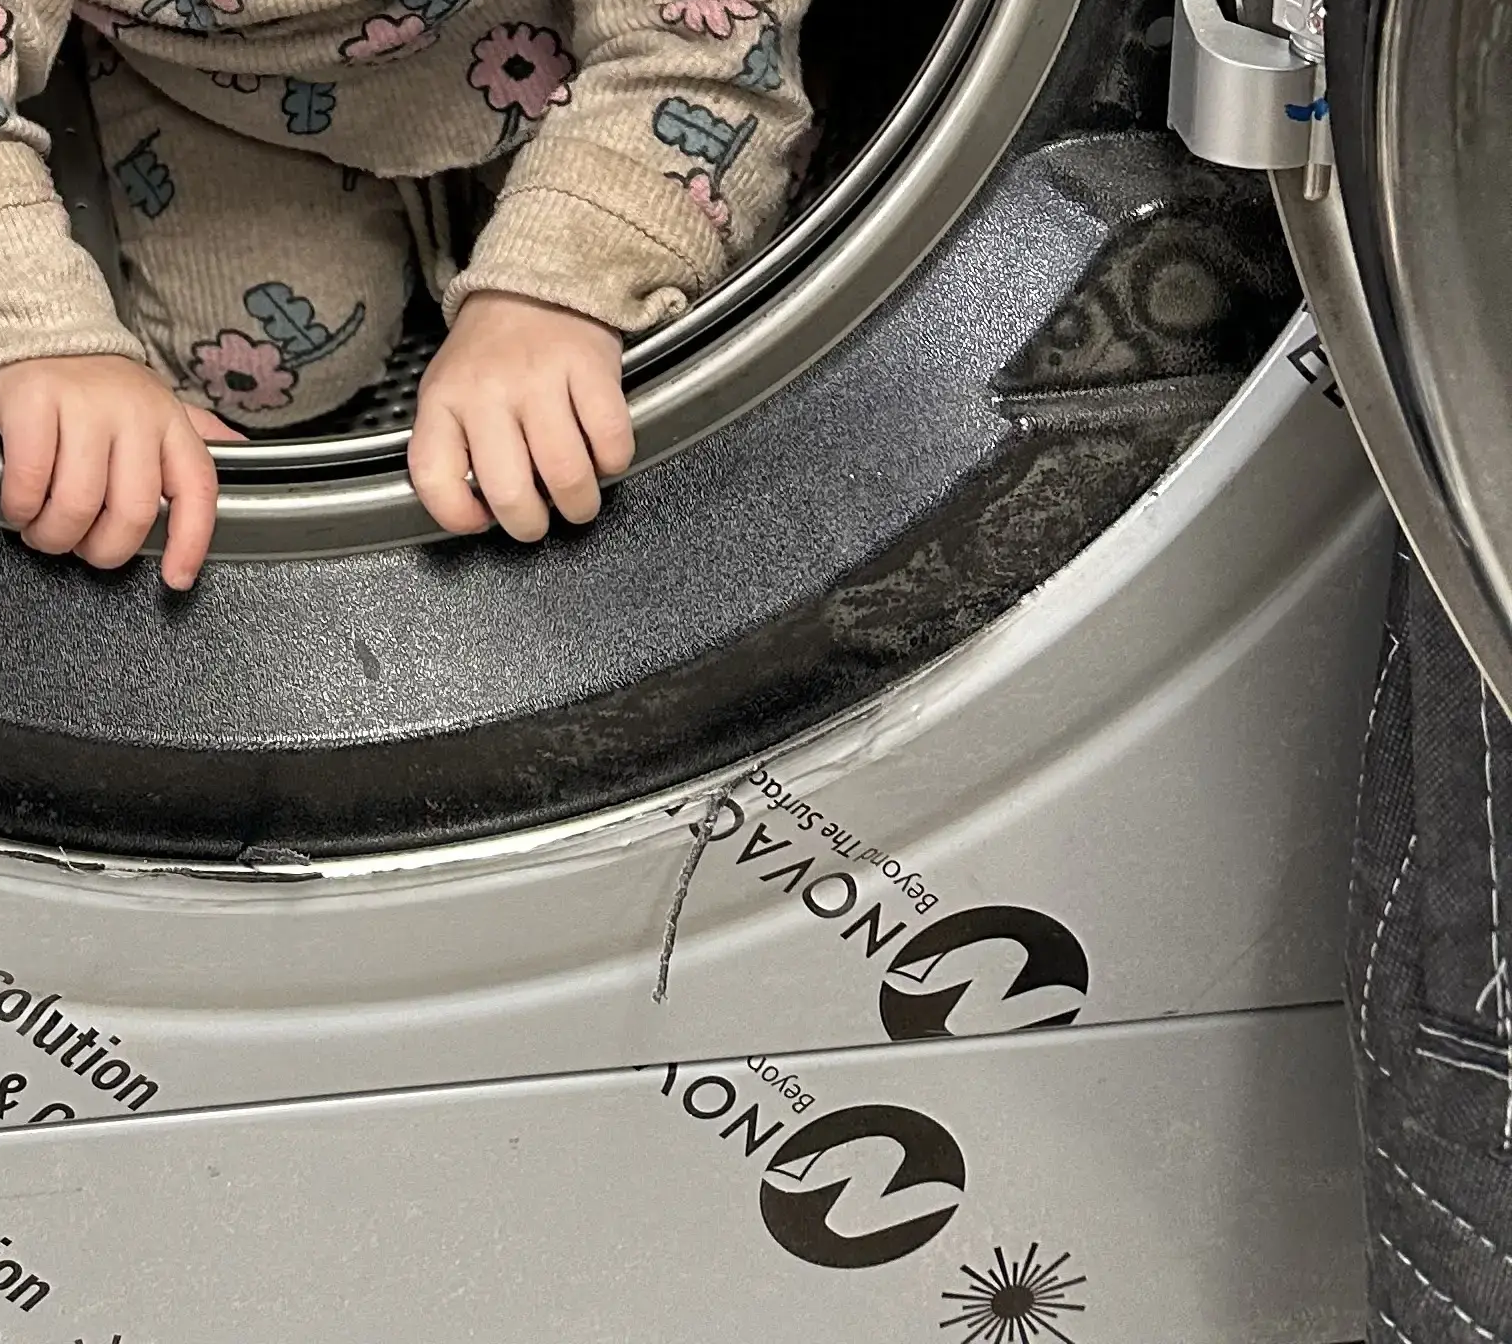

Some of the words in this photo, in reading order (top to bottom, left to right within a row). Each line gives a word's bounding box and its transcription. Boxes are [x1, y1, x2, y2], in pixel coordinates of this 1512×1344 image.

[821, 818, 866, 861] The
[662, 796, 909, 961] NOVAC
[859, 846, 941, 916] Beyond
